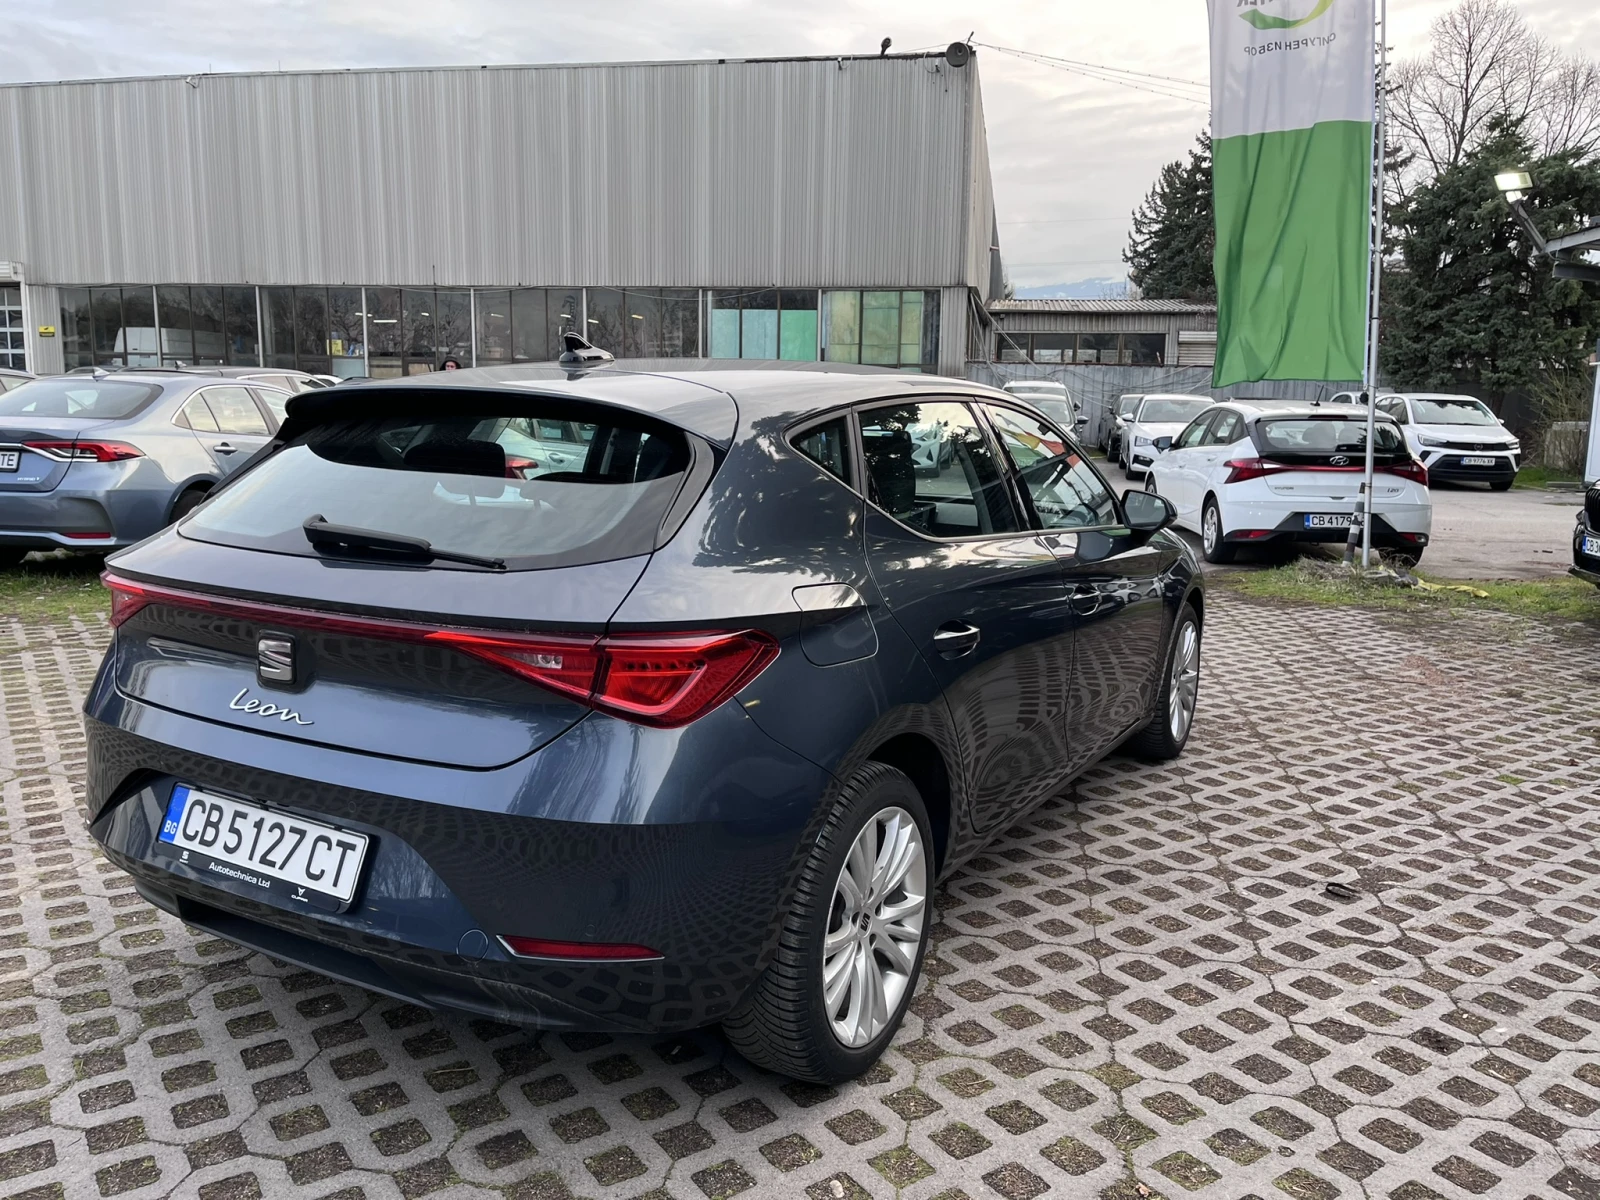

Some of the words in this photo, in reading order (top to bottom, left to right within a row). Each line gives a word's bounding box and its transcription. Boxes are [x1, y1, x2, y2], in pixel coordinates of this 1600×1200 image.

[229, 688, 314, 725] Leon
[163, 820, 178, 835] BG
[209, 862, 257, 884] Autotechnica
[258, 878, 271, 888] Ltd
